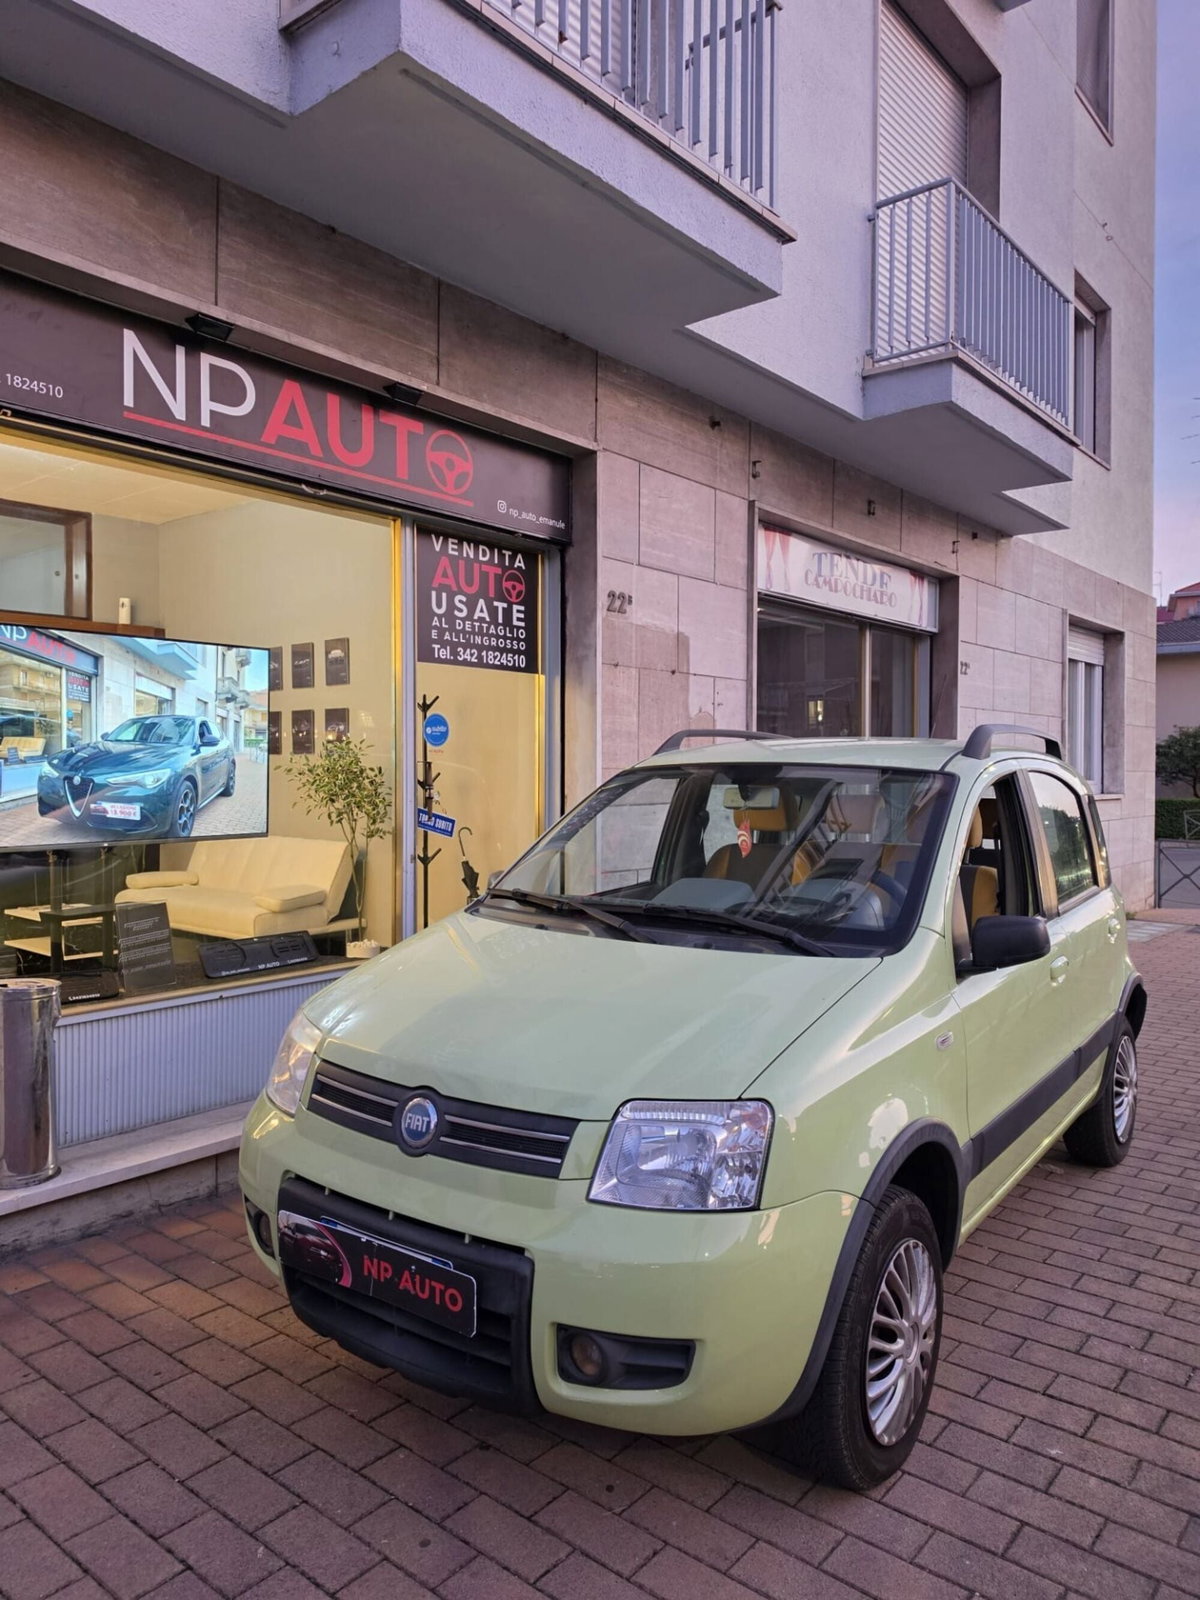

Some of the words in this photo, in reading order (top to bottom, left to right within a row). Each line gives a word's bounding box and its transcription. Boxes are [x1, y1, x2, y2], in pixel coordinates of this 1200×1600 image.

[5, 373, 64, 399] 1824510
[123, 327, 256, 428] NP
[431, 534, 526, 570] VENDITA
[431, 590, 526, 627] USATE
[431, 616, 449, 629] AL
[455, 619, 526, 639] DETTAGLIO
[431, 629, 438, 639] E
[443, 631, 526, 651] ALL'INGROSSO
[431, 644, 454, 660] Tel.
[457, 647, 479, 663] 342
[481, 651, 526, 668] 1824510
[405, 1112, 430, 1133] FIAT
[363, 1254, 393, 1282] NP
[398, 1269, 463, 1312] AUTO
